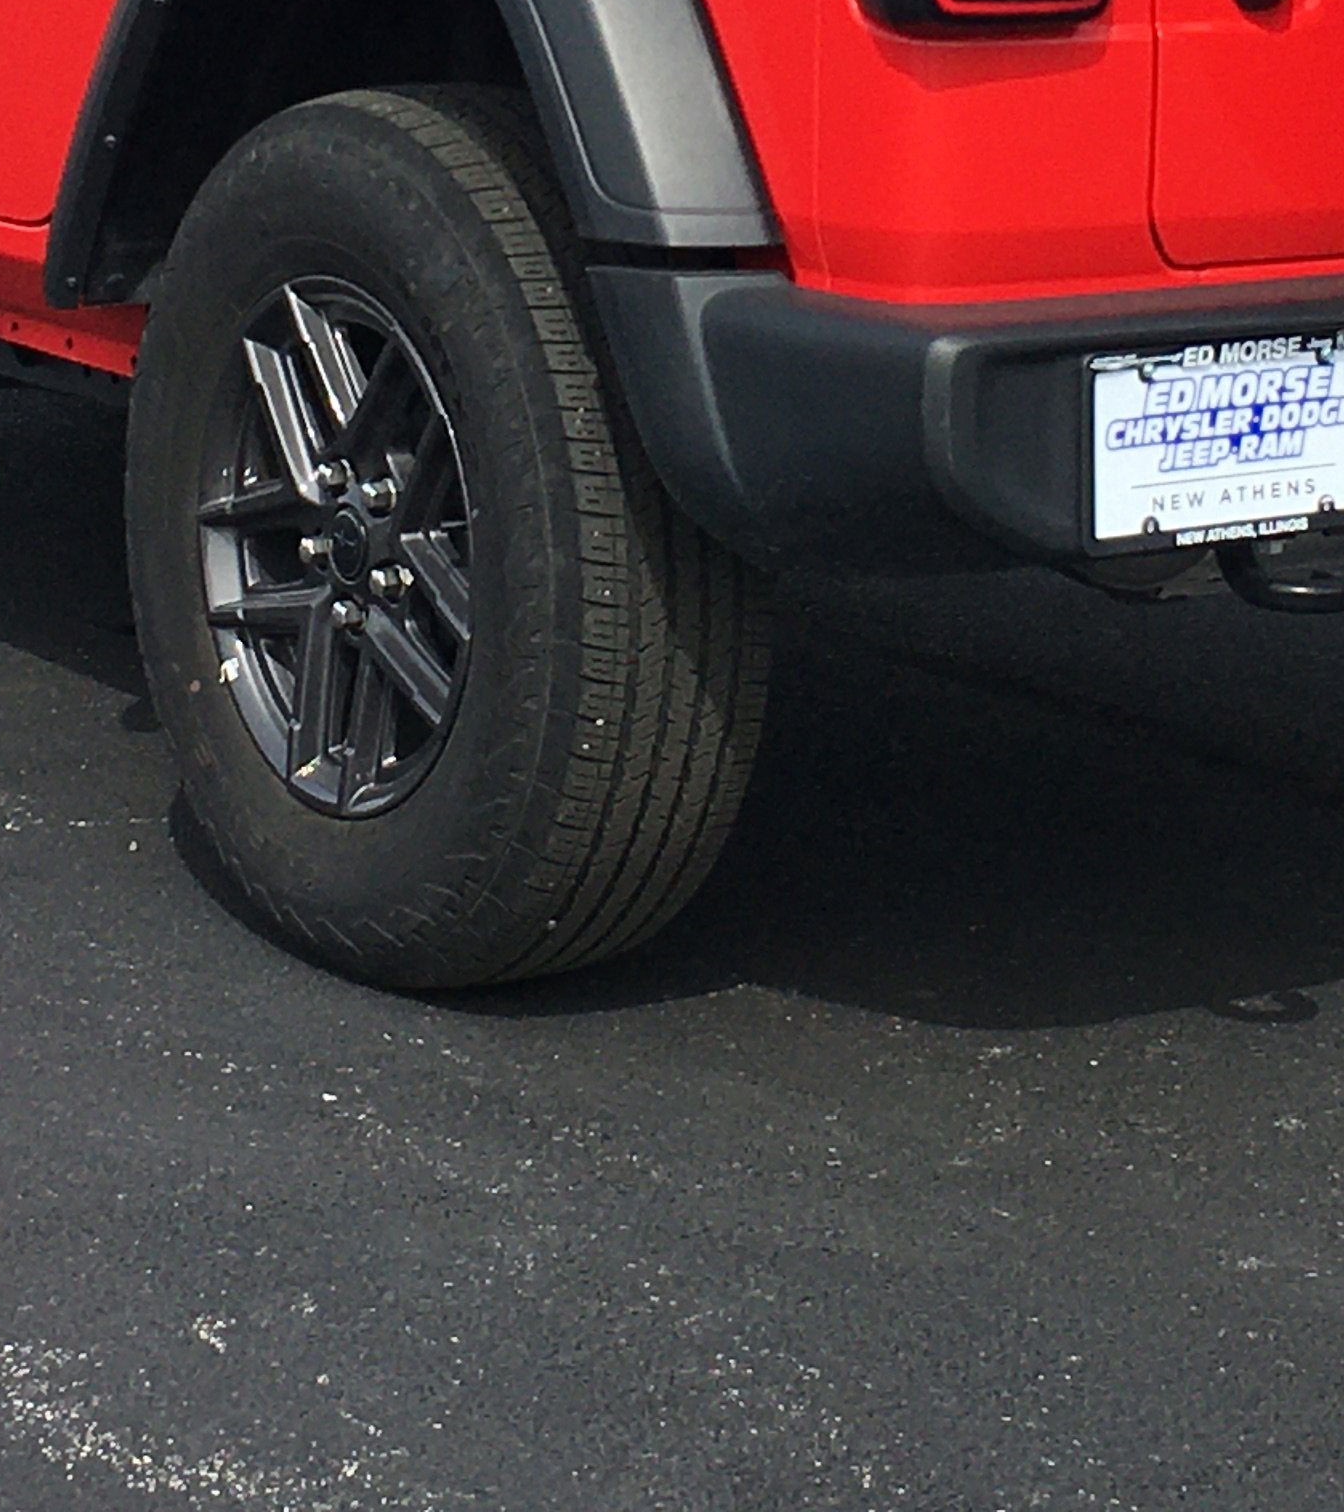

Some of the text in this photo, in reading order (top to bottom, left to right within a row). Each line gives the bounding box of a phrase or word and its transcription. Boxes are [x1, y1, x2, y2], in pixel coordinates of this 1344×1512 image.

[1182, 346, 1214, 368] ED
[1219, 336, 1302, 364] MORSE
[1143, 364, 1334, 415] ED MORSE
[1152, 478, 1316, 513] NEW ATHENS
[1176, 529, 1205, 547] NEW
